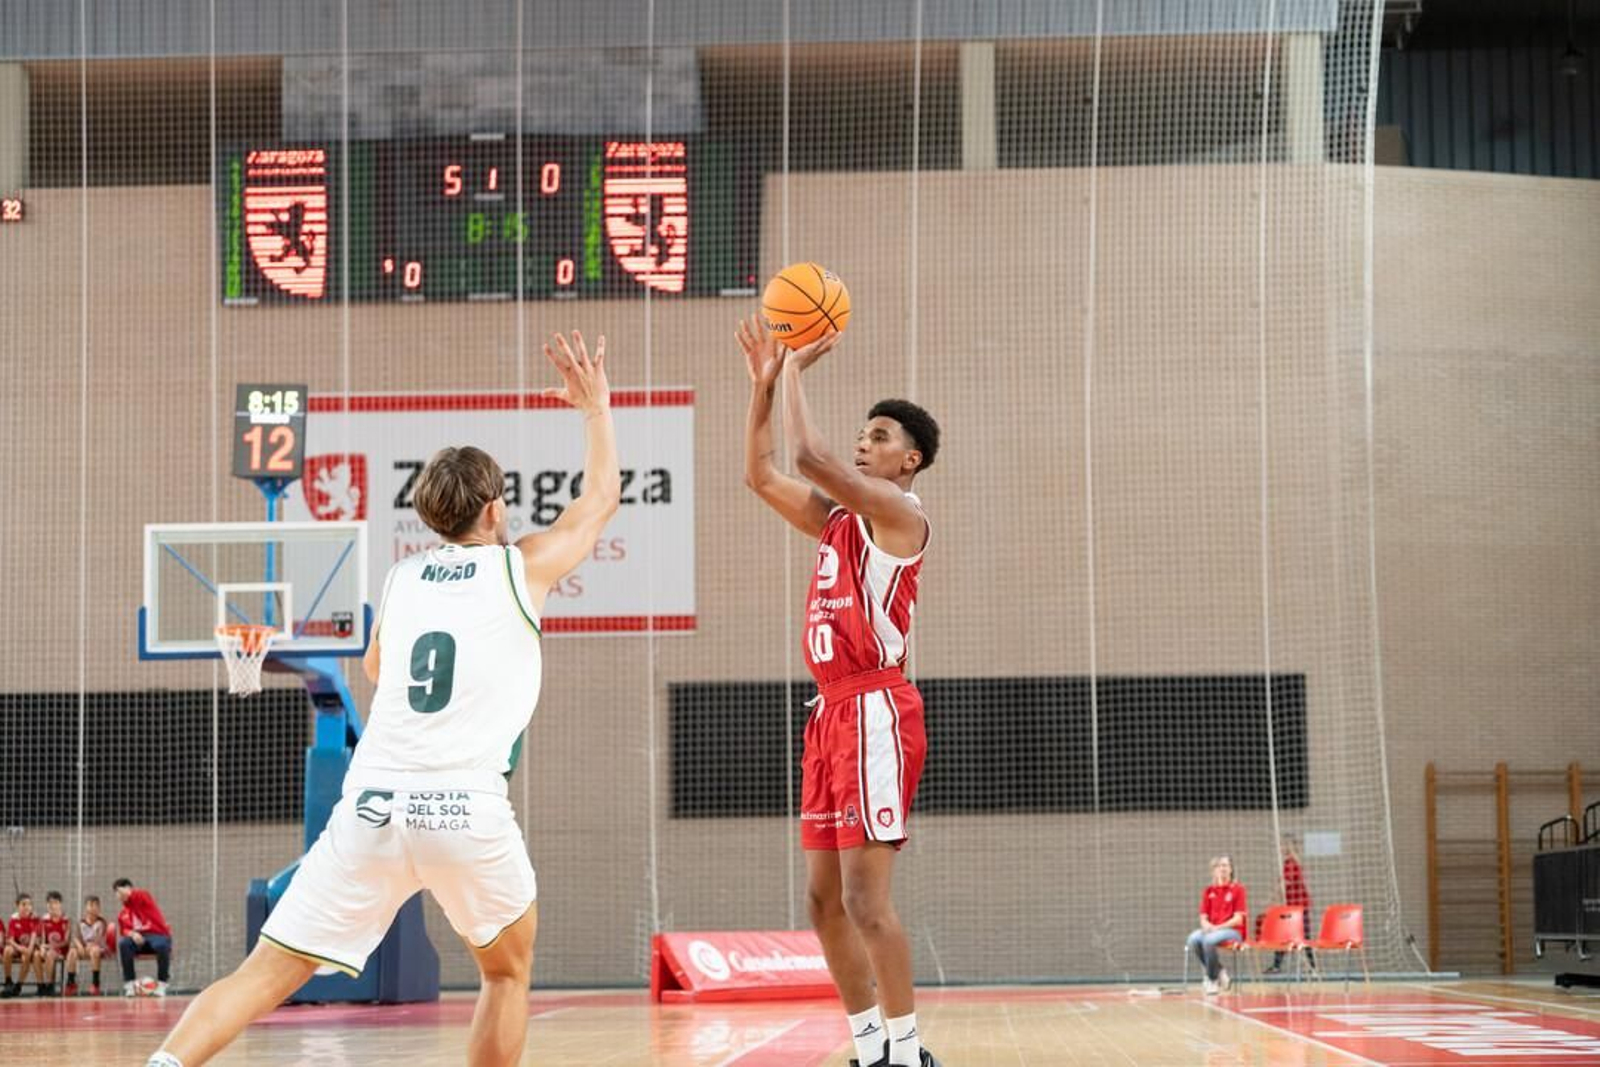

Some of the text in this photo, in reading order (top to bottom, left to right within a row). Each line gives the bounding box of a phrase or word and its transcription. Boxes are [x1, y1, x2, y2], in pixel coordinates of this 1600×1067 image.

[443, 164, 463, 196] 5
[488, 167, 498, 191] 1
[541, 162, 561, 194] 0
[403, 261, 422, 288] 0
[556, 258, 575, 285] 0
[248, 390, 299, 415] 8:15
[242, 425, 295, 471] 12
[808, 624, 834, 664] 10
[407, 630, 456, 713] 9
[406, 803, 471, 816] DEL SOL
